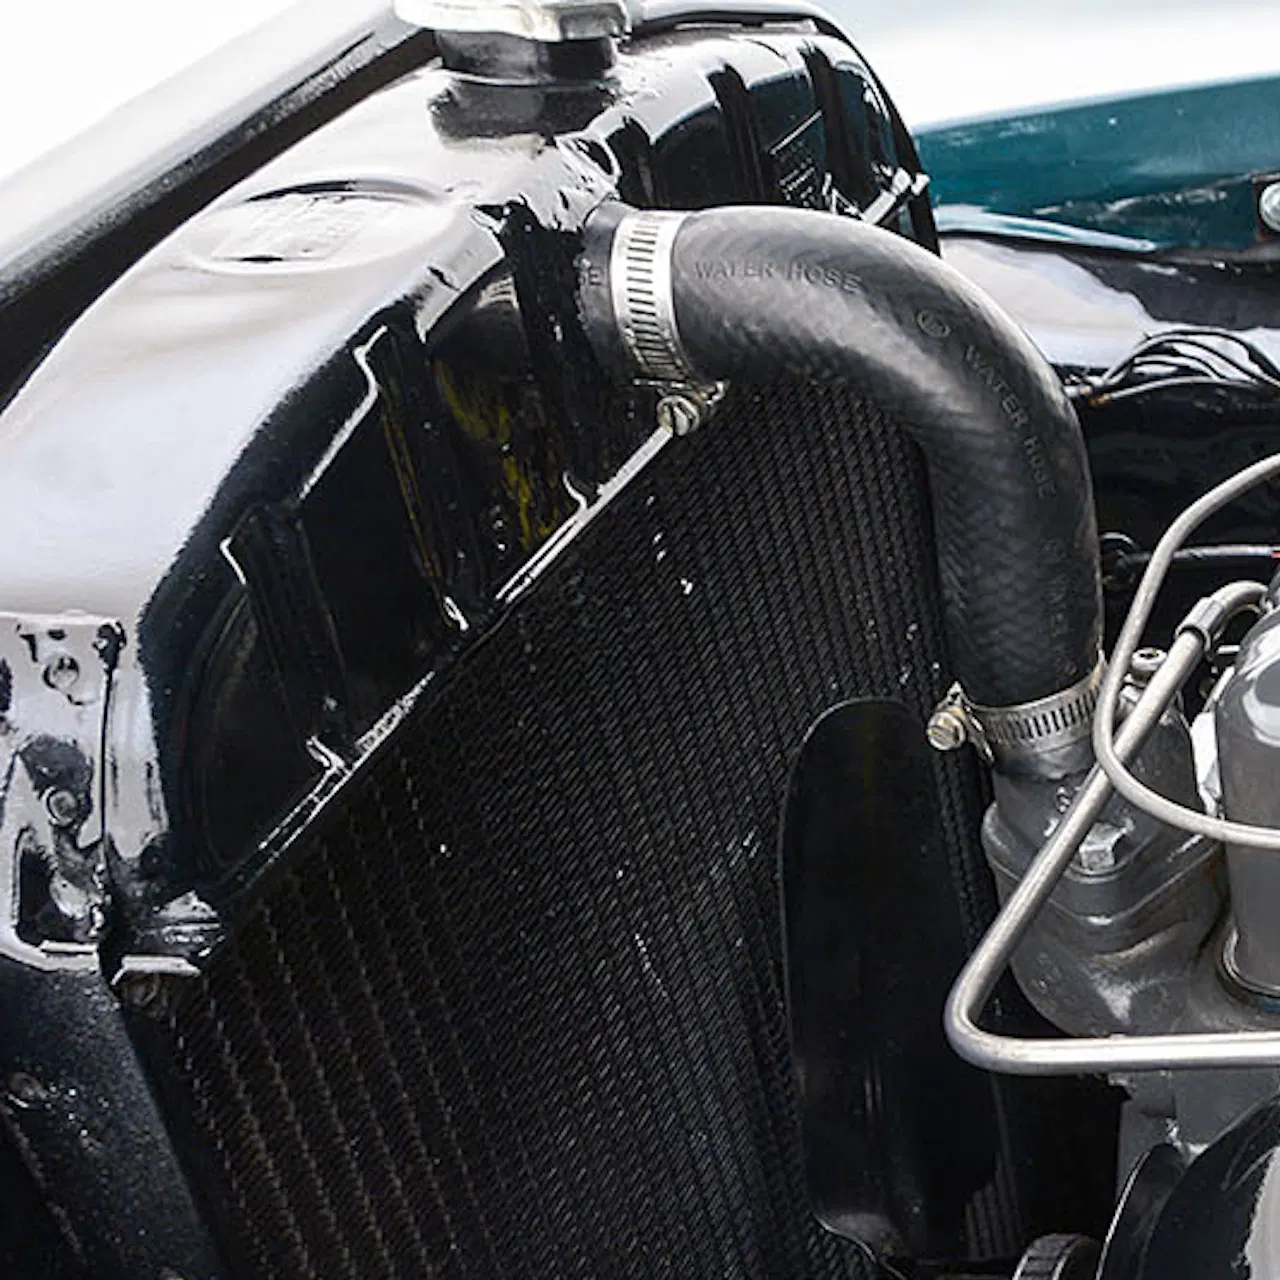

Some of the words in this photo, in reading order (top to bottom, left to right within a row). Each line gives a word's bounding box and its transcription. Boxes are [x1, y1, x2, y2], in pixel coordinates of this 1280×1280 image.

[695, 260, 776, 279] WATER
[786, 260, 866, 294] HOSE
[961, 345, 1030, 428] WATER
[1022, 435, 1058, 499] HOSE
